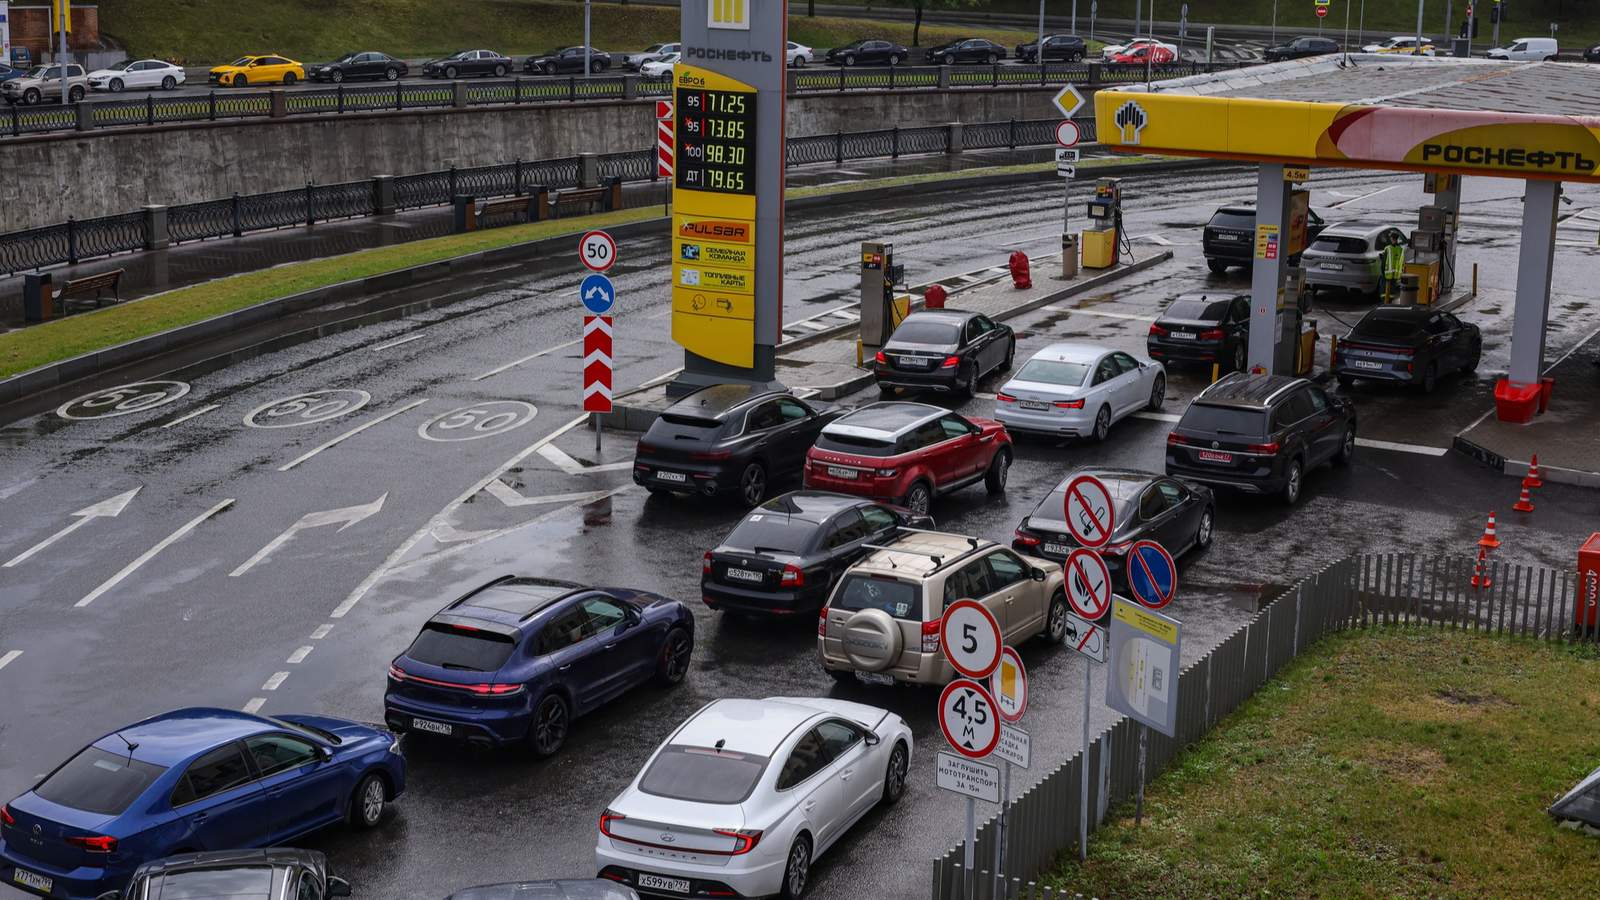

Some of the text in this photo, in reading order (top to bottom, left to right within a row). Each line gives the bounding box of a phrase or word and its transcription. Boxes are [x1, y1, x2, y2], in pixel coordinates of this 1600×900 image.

[687, 47, 772, 62] РОСНЕФТЬ
[687, 93, 745, 114] 95 71.25
[687, 119, 745, 139] 95 73.85
[687, 144, 745, 165] 100 98.30
[1423, 144, 1595, 171] РОСНЕФТЬ
[686, 169, 744, 190] ДТ 79.65
[587, 243, 608, 259] 50
[705, 247, 746, 256] СЕМЕЙНАЯ
[709, 253, 745, 262] КОМАНДА
[704, 272, 745, 281] ТОПЛИВНЫЕ
[720, 279, 746, 287] КАРТЫ
[82, 389, 167, 409] 50
[267, 397, 349, 418] 50
[439, 409, 517, 431] 50
[962, 623, 978, 654] 5
[952, 695, 987, 725] 4,5
[938, 767, 998, 789] МОТОТРАНСПОРТ
[948, 760, 988, 777] ЗАГЛУШИТЬ
[956, 781, 965, 789] ЗА
